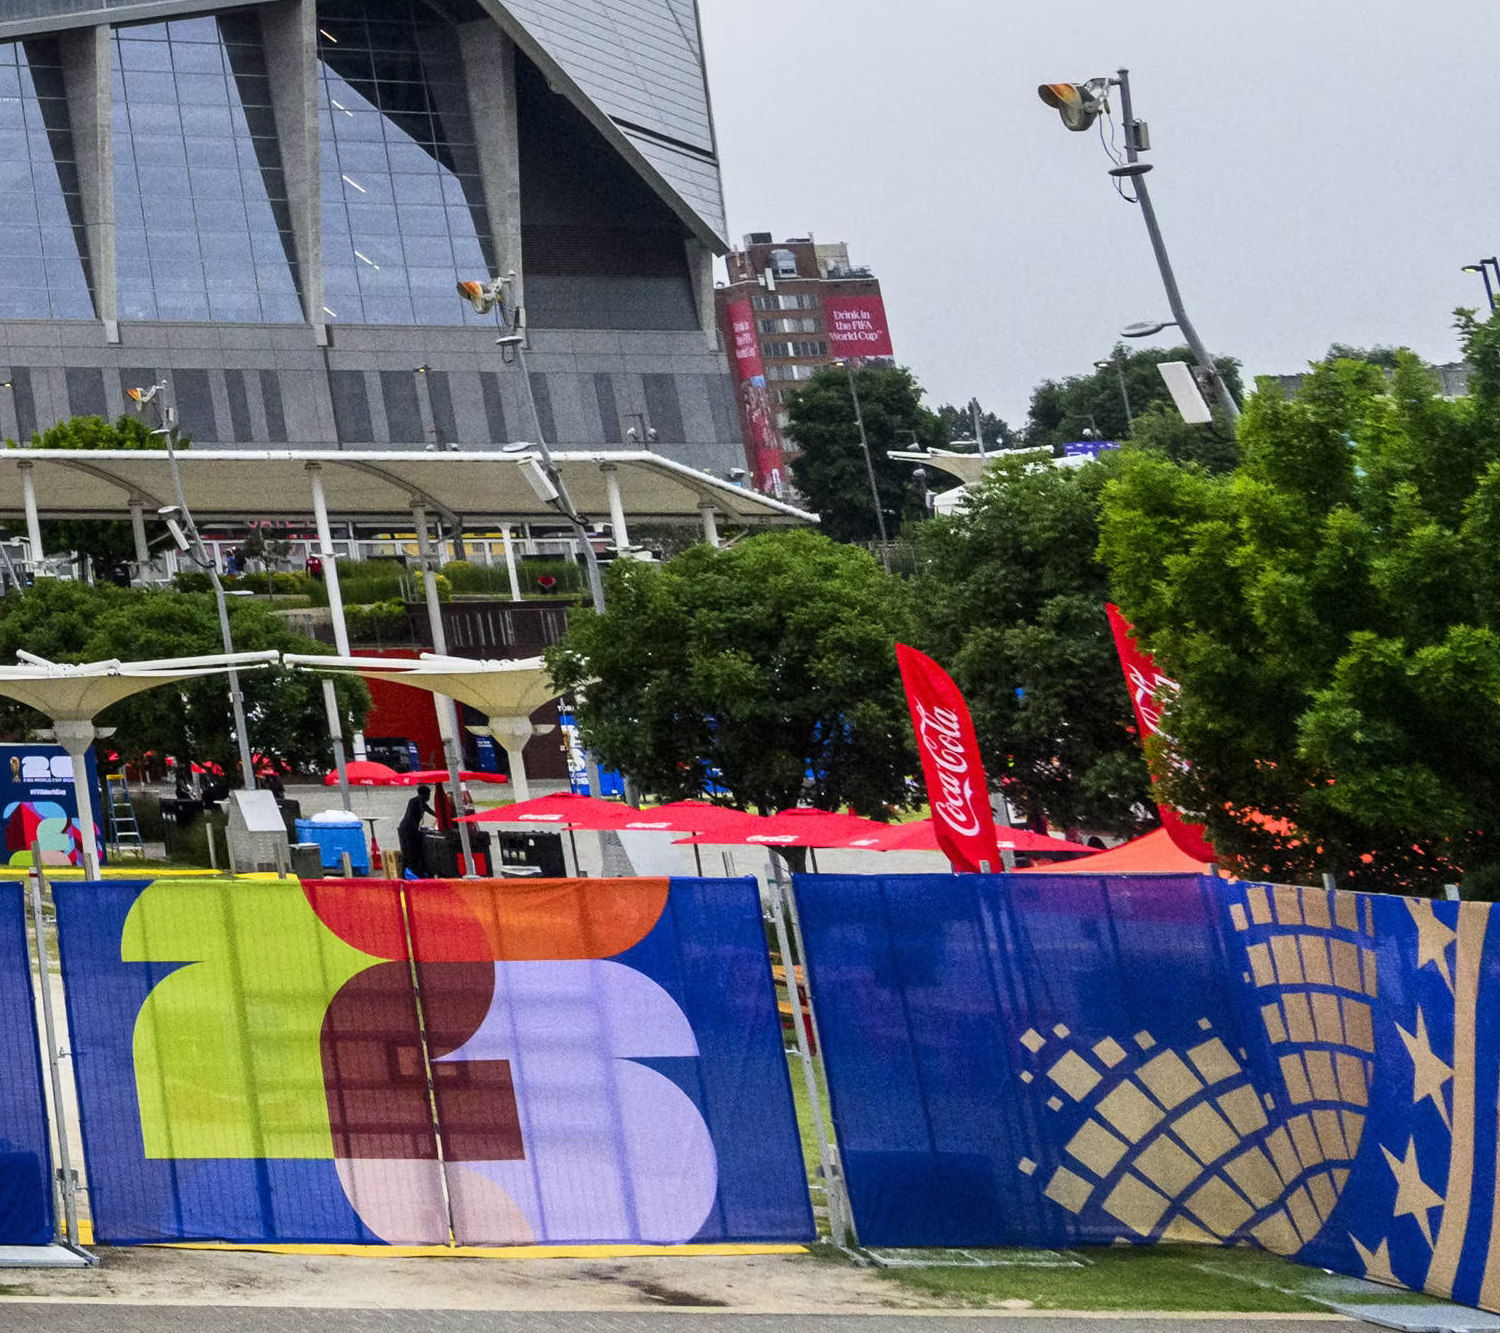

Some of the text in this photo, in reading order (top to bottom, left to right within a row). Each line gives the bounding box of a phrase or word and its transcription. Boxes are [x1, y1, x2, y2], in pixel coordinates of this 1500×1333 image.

[833, 311, 871, 320] Drink in
[836, 321, 873, 331] the FIFA
[913, 694, 980, 837] Coca-Cola
